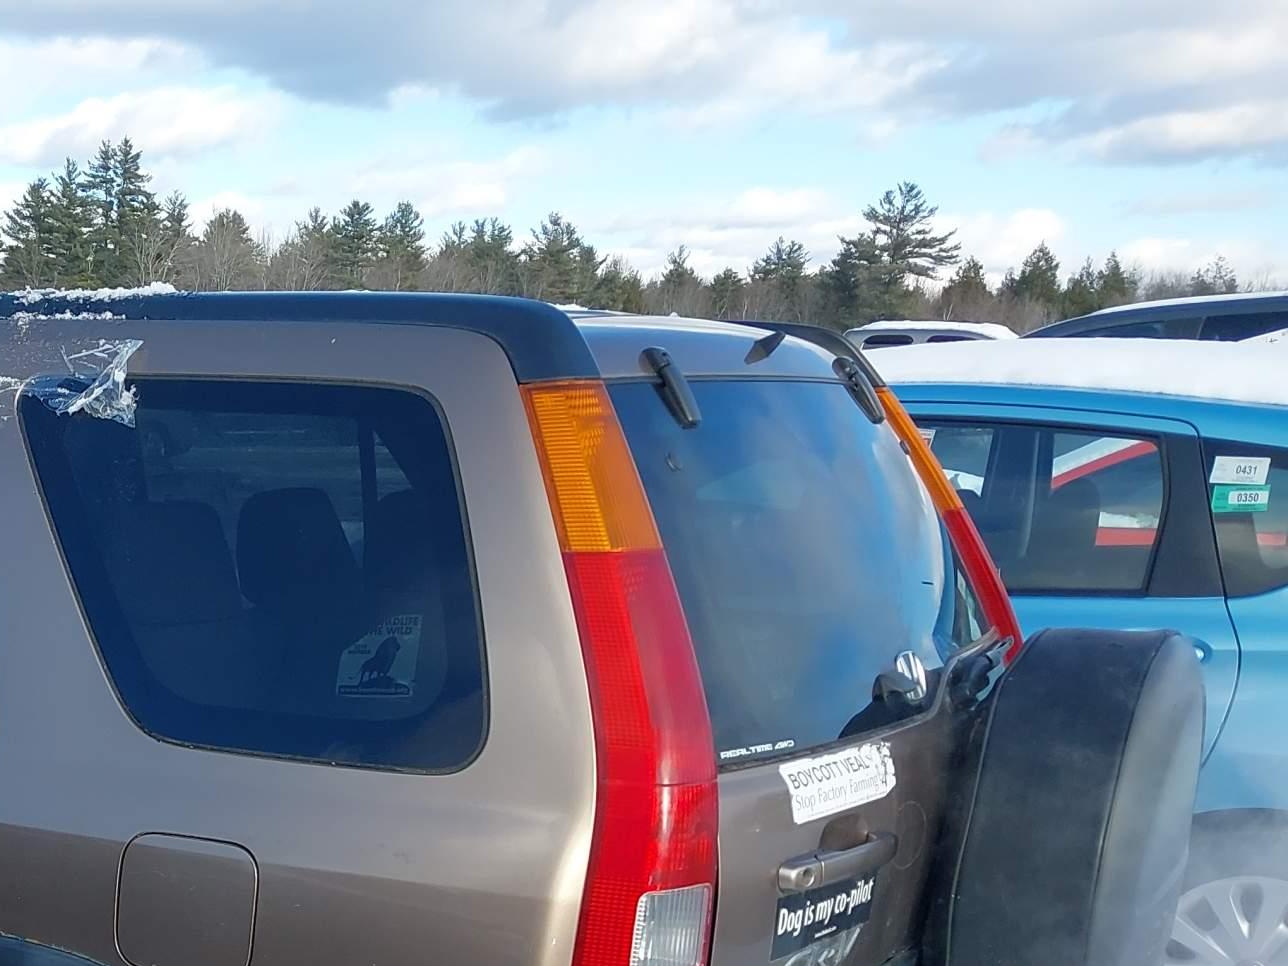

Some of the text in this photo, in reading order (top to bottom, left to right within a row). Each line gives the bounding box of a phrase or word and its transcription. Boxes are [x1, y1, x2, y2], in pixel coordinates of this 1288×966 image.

[1236, 465, 1258, 475] 0431
[1237, 493, 1259, 502] 0350
[787, 754, 870, 789] BOYCOTT VEAL
[795, 793, 816, 811] Stop
[817, 784, 848, 802] Factory
[777, 908, 803, 937] Dog
[804, 900, 815, 926] is
[815, 896, 834, 925] my
[834, 878, 875, 914] co-pilot
